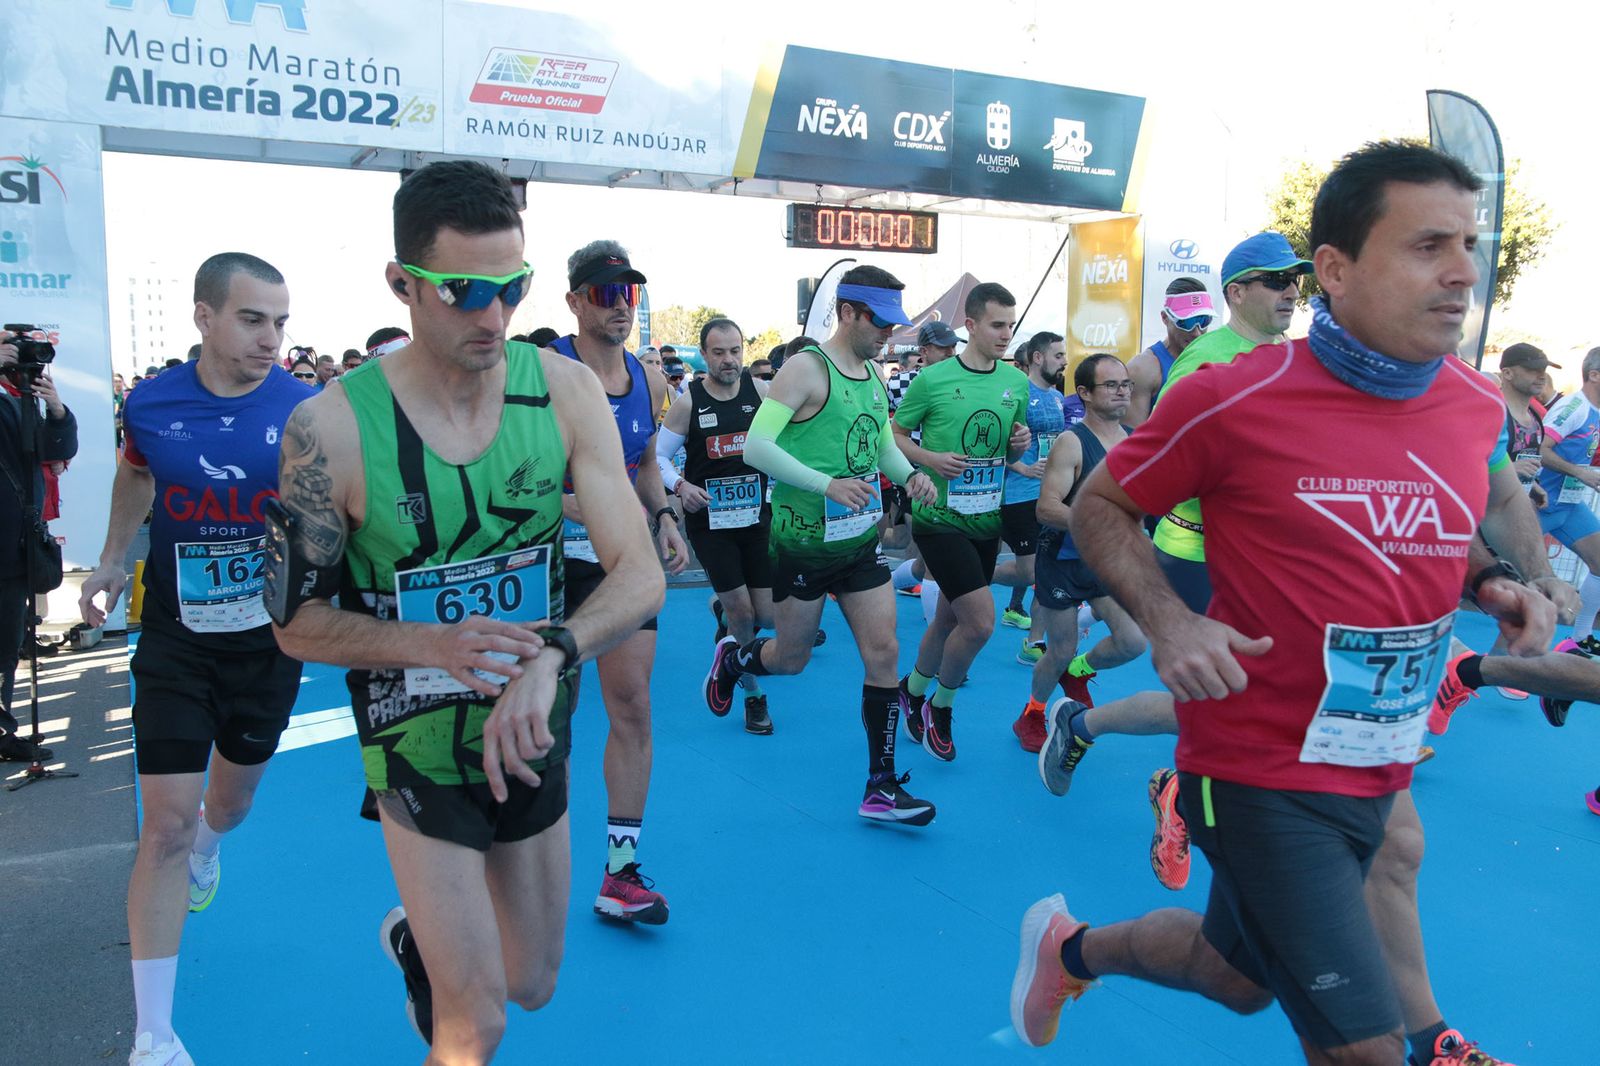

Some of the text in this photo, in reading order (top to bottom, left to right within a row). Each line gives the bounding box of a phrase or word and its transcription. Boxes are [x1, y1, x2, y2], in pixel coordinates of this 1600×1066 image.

[105, 26, 400, 87] Medio Maratón
[531, 78, 581, 89] RUNNING
[536, 70, 607, 84] ATLETISMO
[105, 65, 281, 116] Almería
[499, 91, 582, 109] Prueba Oficial
[815, 98, 837, 107] GRUPO
[797, 104, 868, 140] NEXA
[893, 111, 951, 144] CDX
[466, 117, 707, 154] RAMÓN RUIZ ANDÚJAR
[907, 142, 933, 150] DEPORTIVO
[976, 154, 1020, 167] ALMERÍA
[1052, 163, 1081, 173] DEPORTES
[986, 166, 1010, 174] CIUDAD
[0, 171, 41, 204] SI
[1082, 255, 1128, 286] NEXA
[1158, 261, 1210, 274] HYUNDAI
[1082, 318, 1124, 347] CDX
[974, 412, 995, 421] HOTEL
[158, 430, 193, 439] SPIRAL
[732, 435, 745, 443] GO
[963, 468, 995, 484] 911
[714, 483, 756, 502] 1500
[1297, 477, 1434, 495] CLUB DEPORTIVO
[200, 526, 248, 536] SPORT
[475, 565, 496, 577] 2022
[208, 584, 243, 596] MARCO
[300, 570, 318, 596] FILA
[435, 574, 523, 624] 630
[1365, 645, 1440, 696] 757
